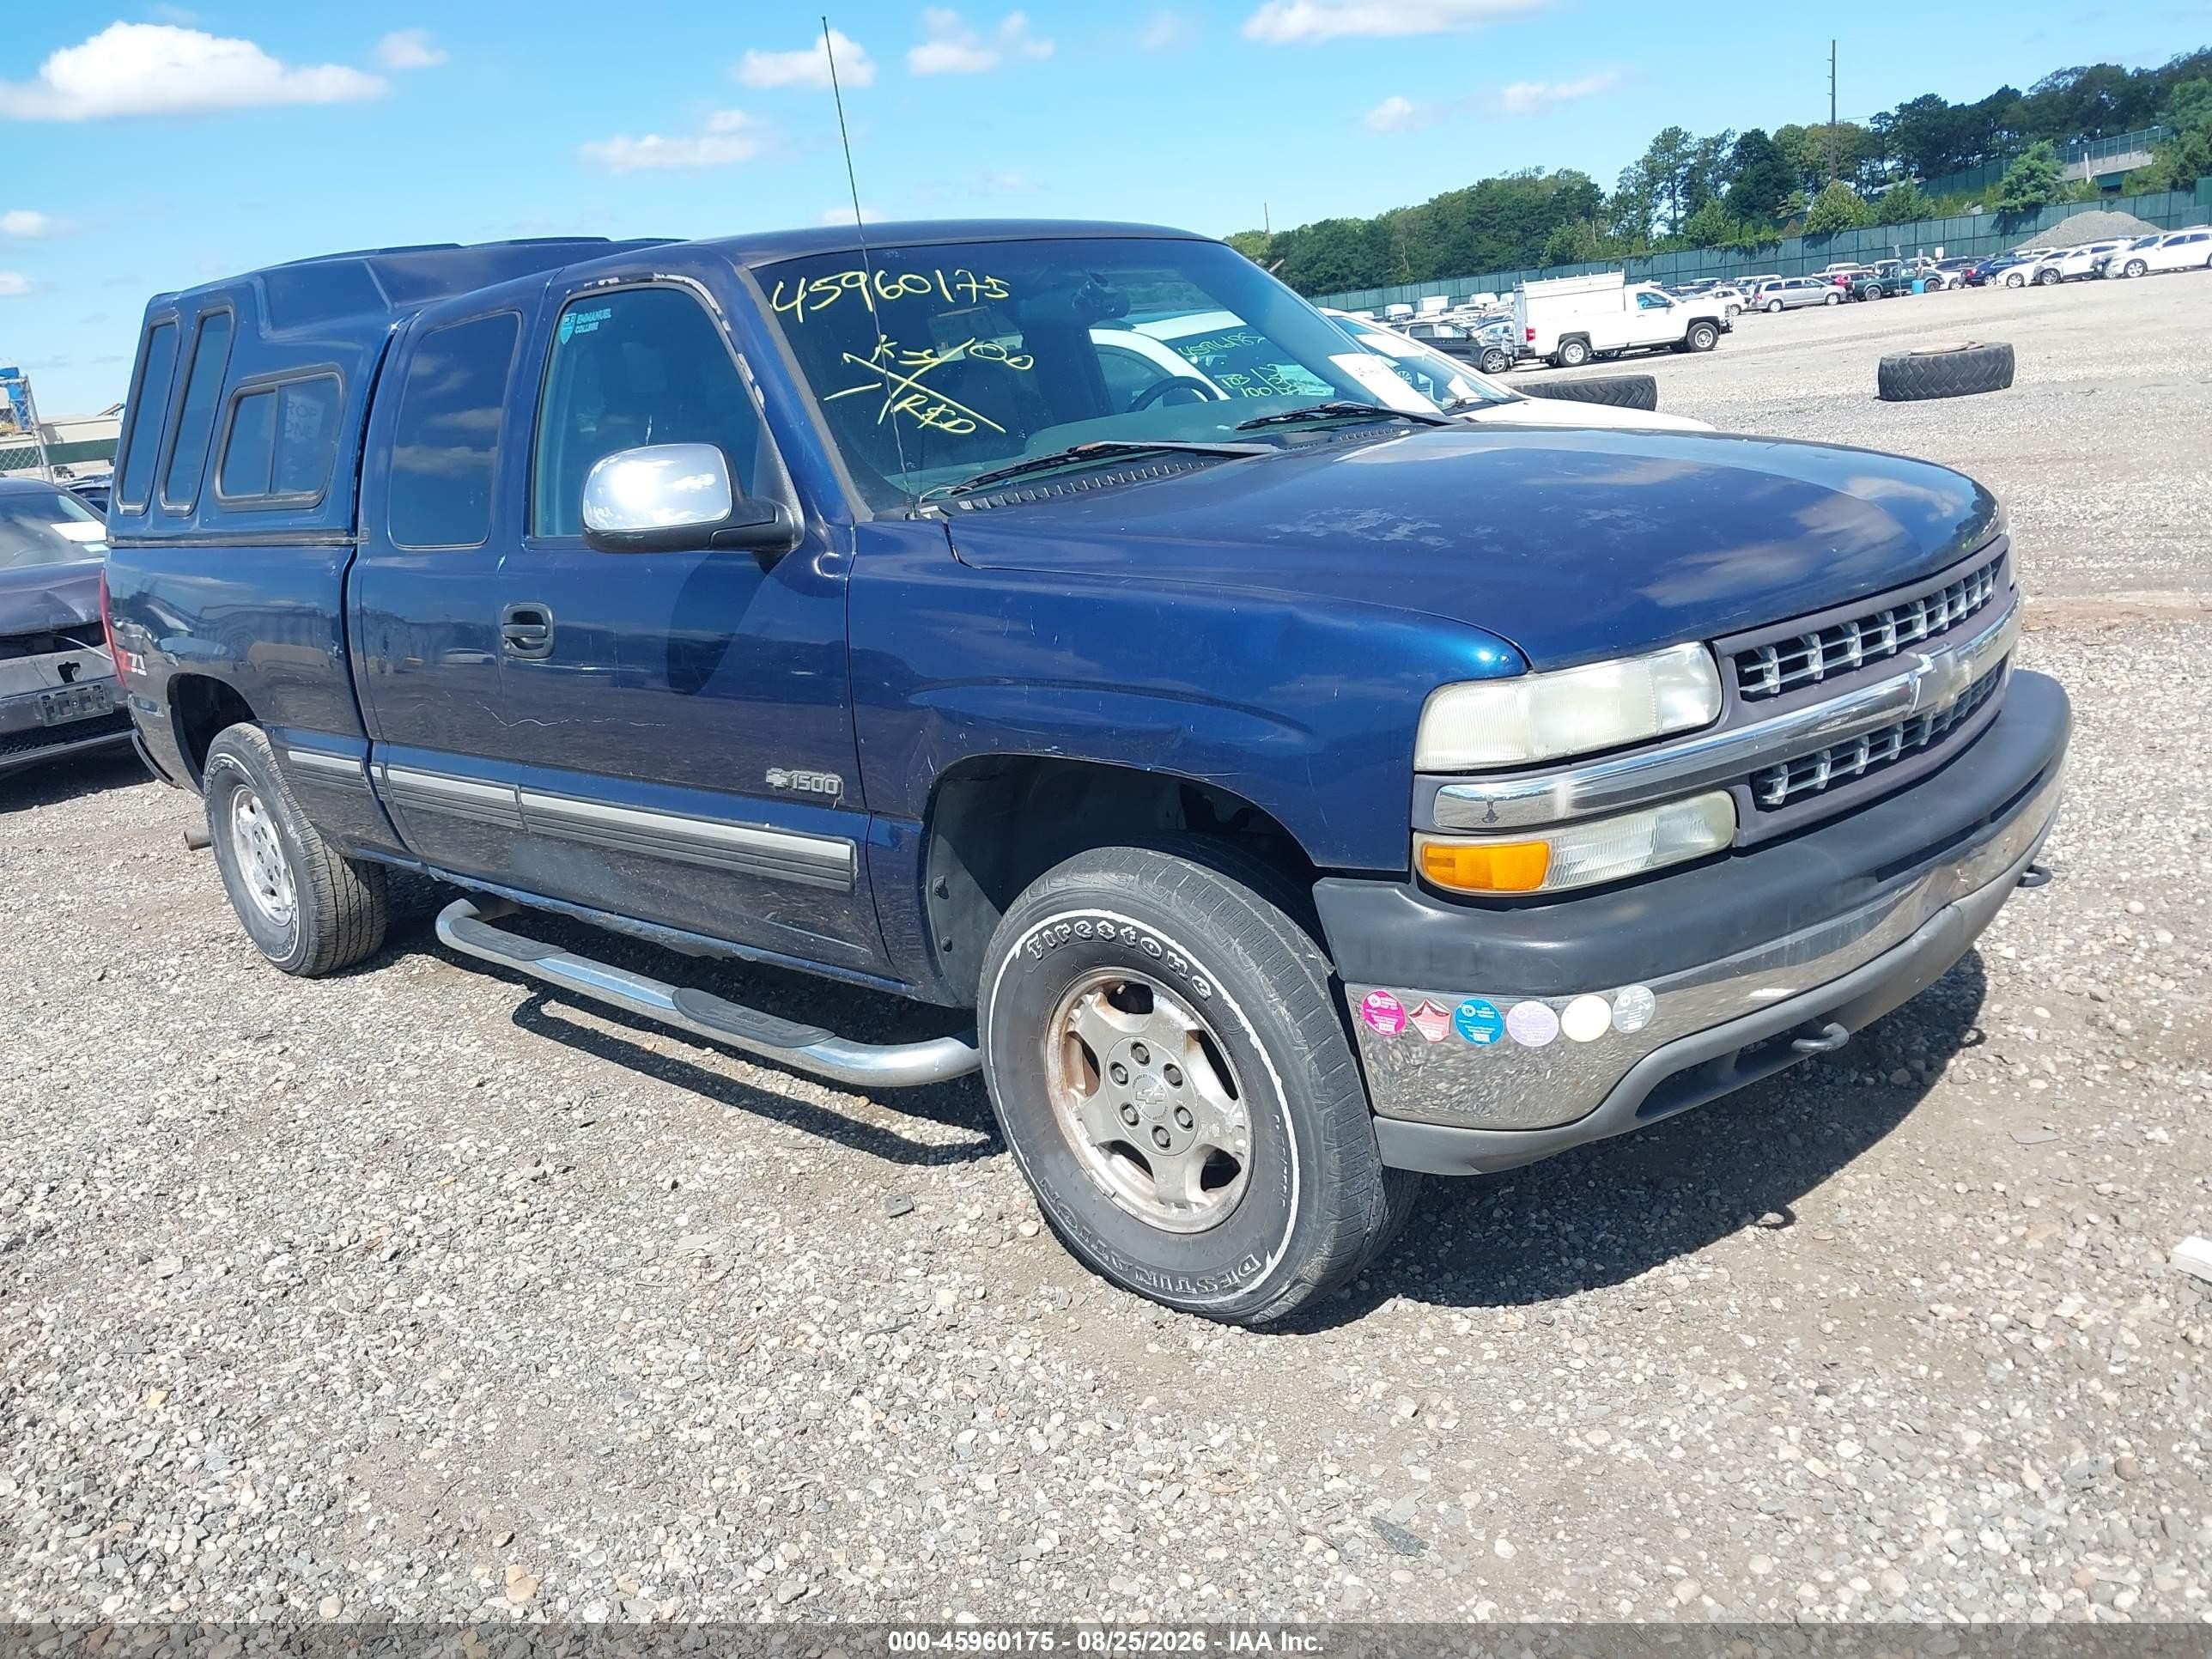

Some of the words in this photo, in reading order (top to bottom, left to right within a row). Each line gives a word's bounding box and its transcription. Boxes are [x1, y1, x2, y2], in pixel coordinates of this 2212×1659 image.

[770, 269, 1010, 322] 45960175
[791, 774, 839, 795] 1500
[1027, 920, 1212, 1000] Firestone
[1039, 1177, 1263, 1294] DESTINATION
